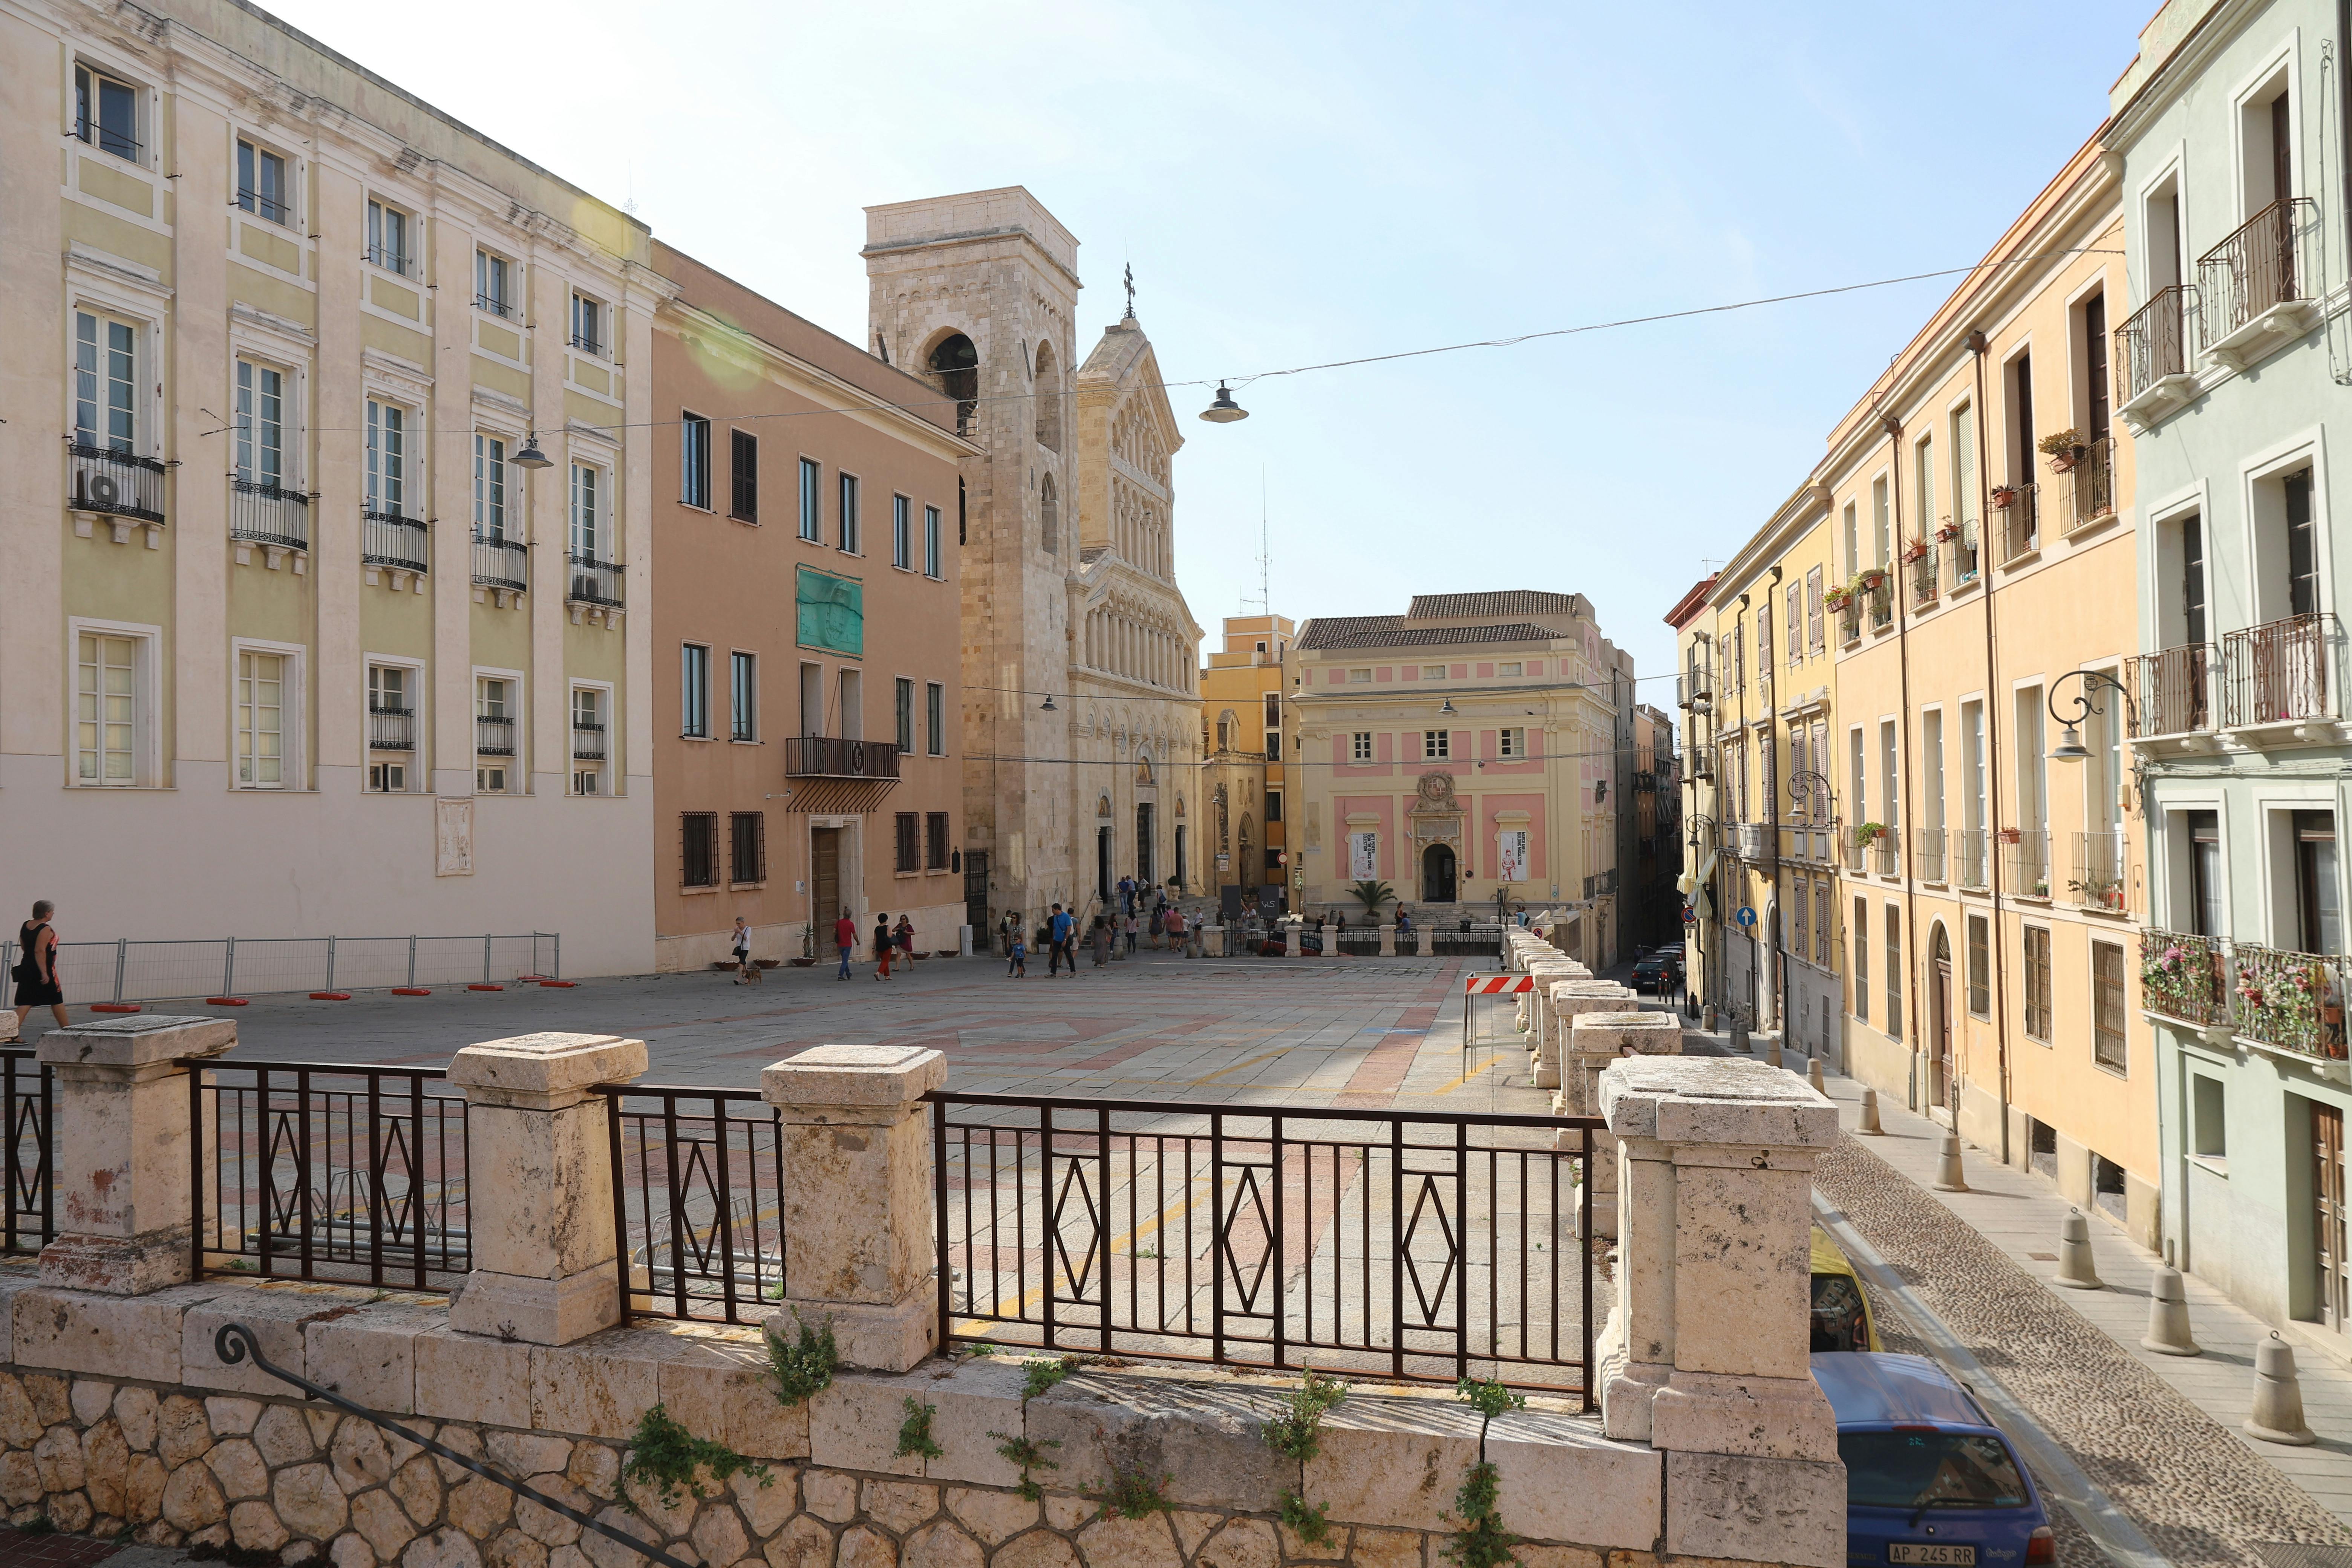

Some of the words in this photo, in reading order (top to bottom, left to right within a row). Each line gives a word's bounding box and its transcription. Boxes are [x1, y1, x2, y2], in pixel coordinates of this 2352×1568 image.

[1893, 1546, 1910, 1560] AP
[1920, 1547, 1947, 1562] 245
[1954, 1548, 1972, 1563] RR
